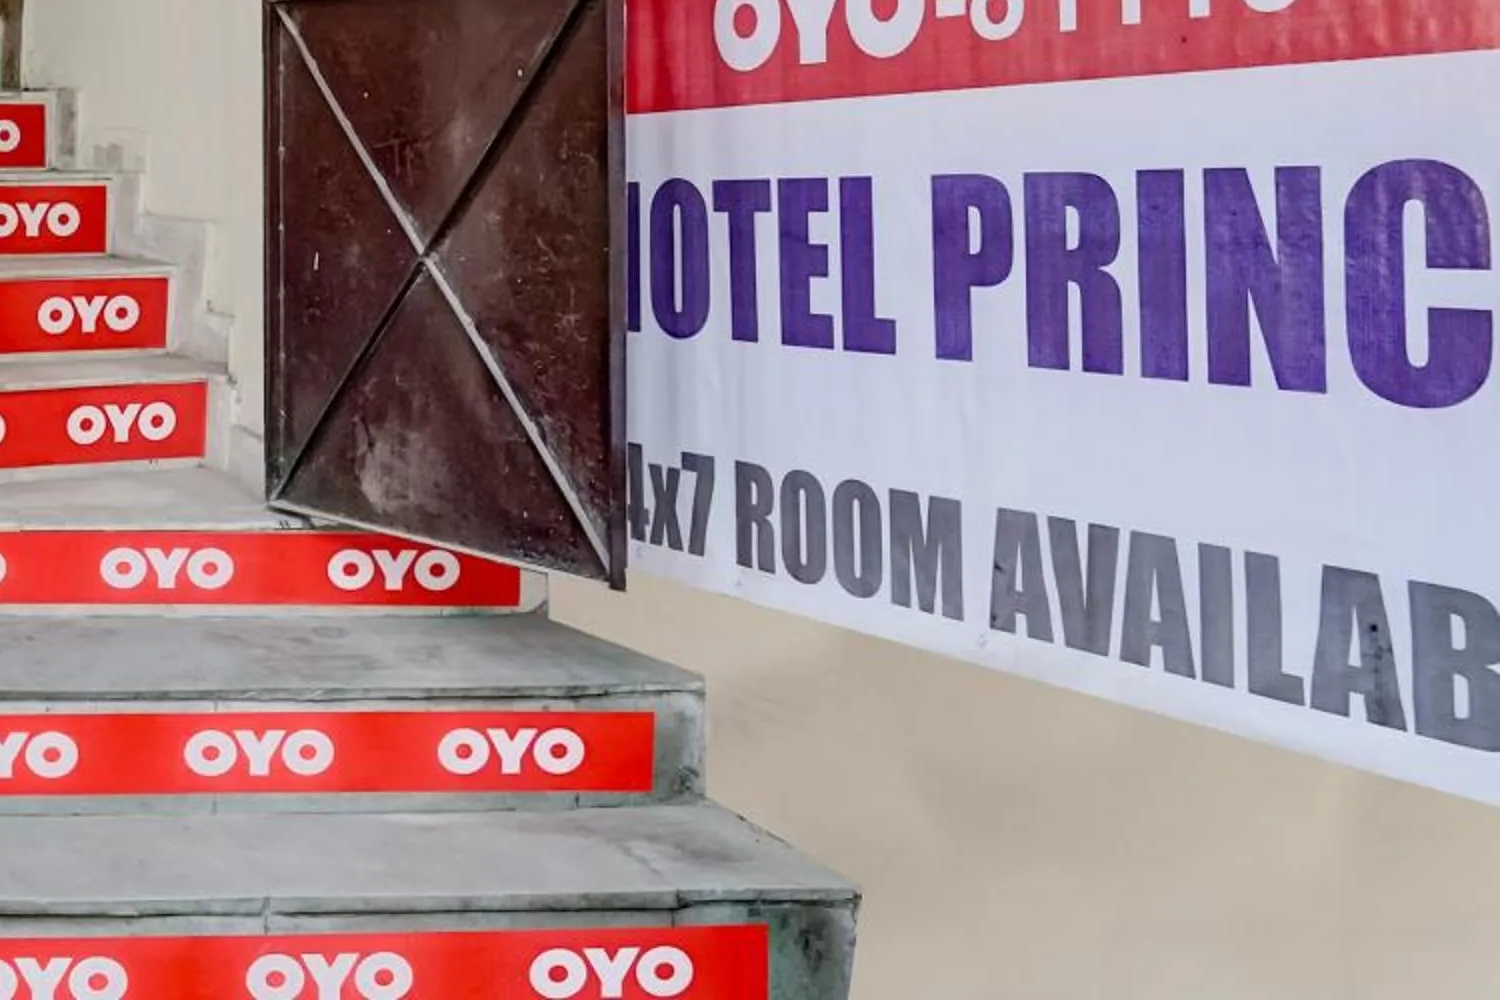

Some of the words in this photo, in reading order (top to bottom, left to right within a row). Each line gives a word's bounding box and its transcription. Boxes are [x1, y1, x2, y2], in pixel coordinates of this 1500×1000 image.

[627, 176, 896, 355] OTEL
[931, 159, 1493, 408] PRINC
[38, 296, 139, 333] OYO
[67, 402, 176, 444] OYO
[100, 548, 233, 589] OYO
[328, 549, 460, 591] OYO
[734, 460, 963, 621] ROOM
[989, 508, 1500, 752] AVAILAB
[184, 729, 334, 776] OYO
[438, 728, 584, 774] OYO
[246, 952, 413, 1000] OYO
[530, 946, 693, 999] OYO
